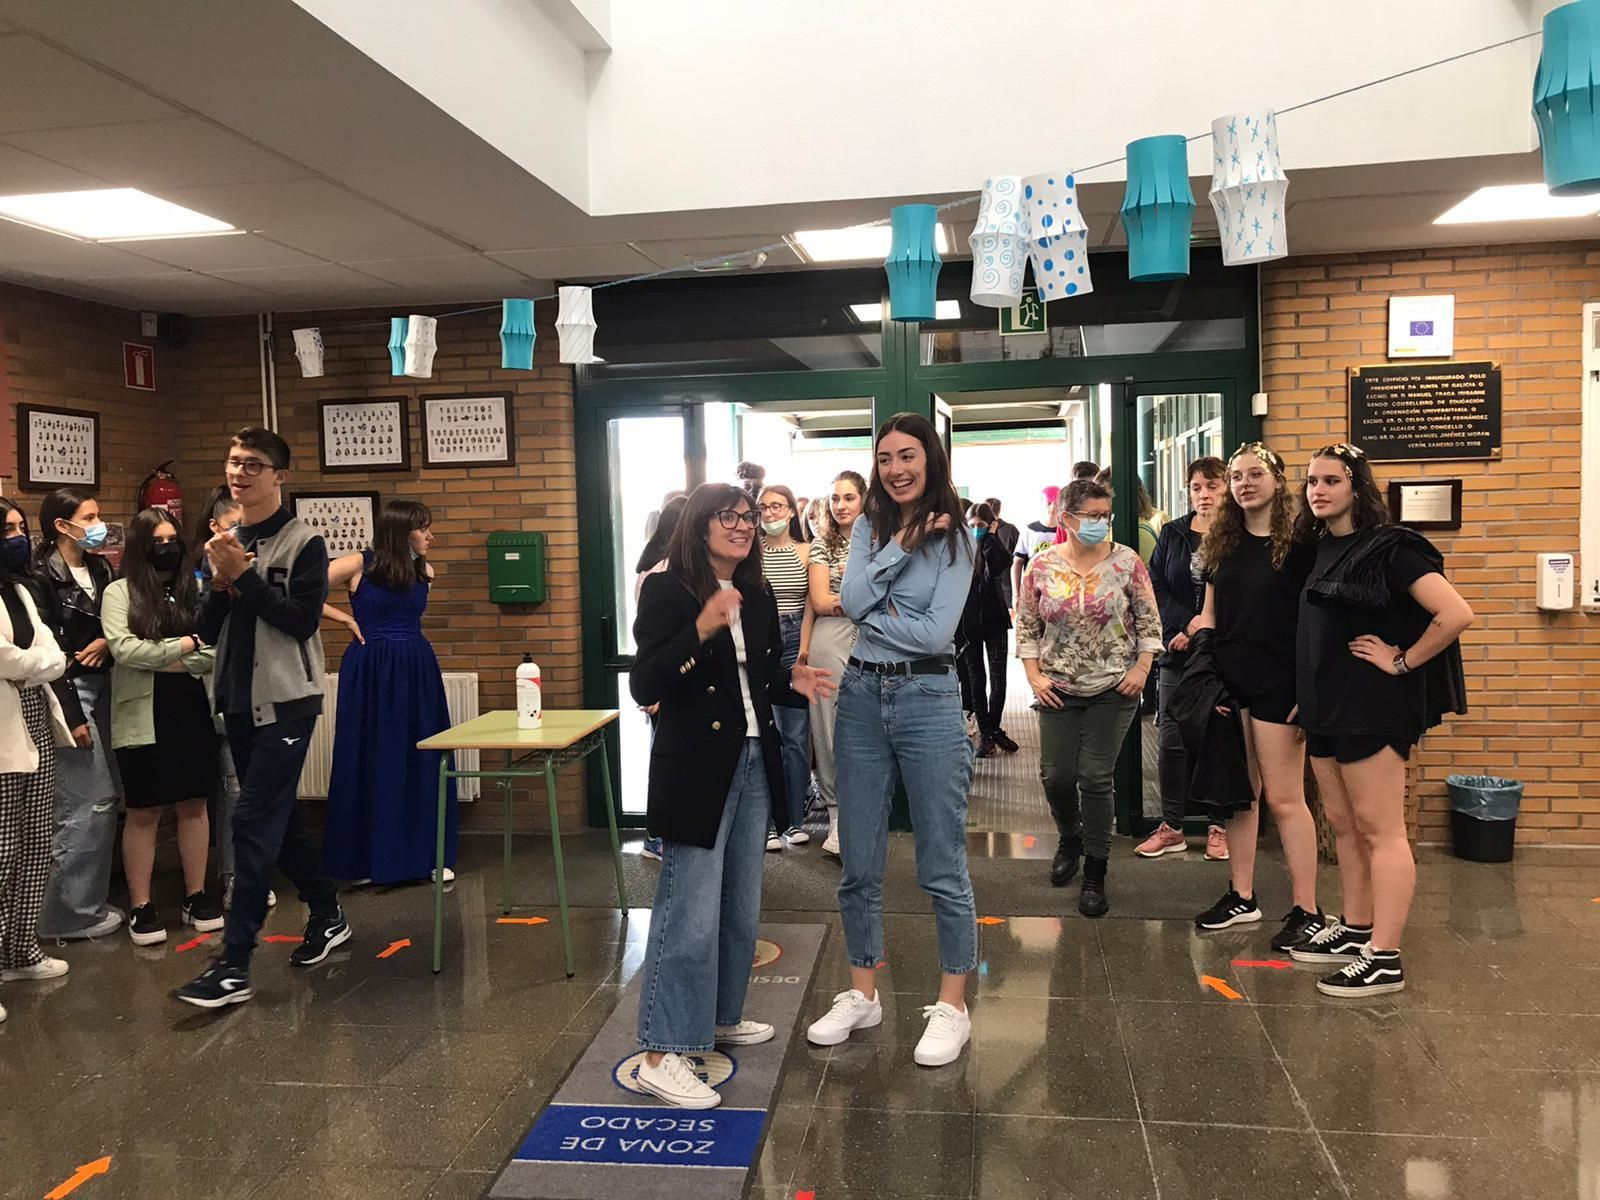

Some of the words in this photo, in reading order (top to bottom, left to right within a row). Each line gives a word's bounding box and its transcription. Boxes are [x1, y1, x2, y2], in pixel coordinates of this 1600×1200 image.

[1392, 399, 1433, 407] CONSELLEIRO
[1453, 413, 1488, 421] FERNÁNDEZ
[1415, 432, 1438, 440] MANUEL
[580, 1115, 715, 1132] SECADO
[559, 1136, 606, 1151] DE
[620, 1139, 715, 1154] ZONA
